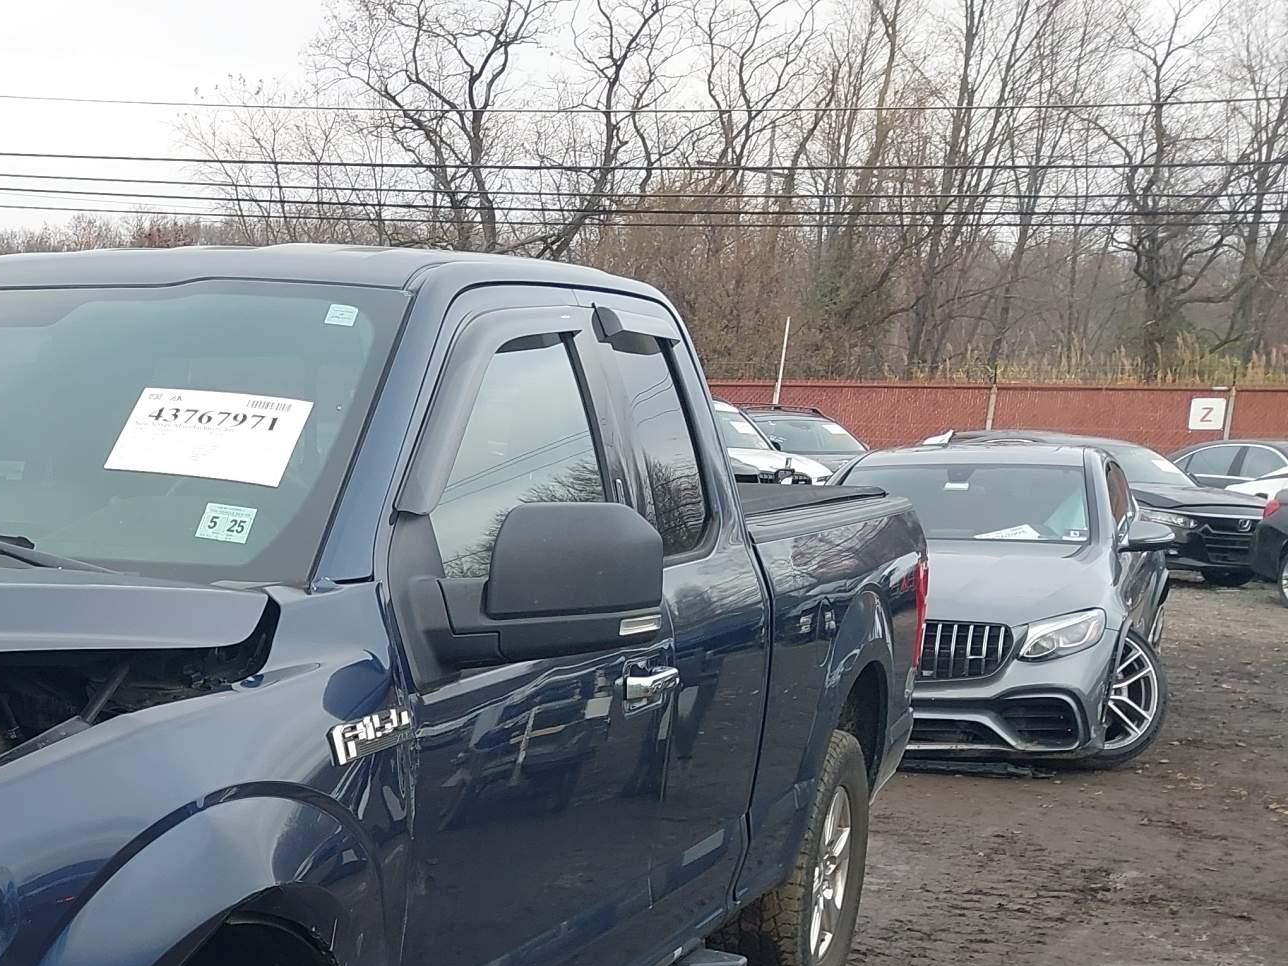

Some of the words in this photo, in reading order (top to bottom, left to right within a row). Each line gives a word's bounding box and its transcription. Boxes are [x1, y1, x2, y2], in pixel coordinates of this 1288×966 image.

[147, 407, 279, 431] 43767971
[1199, 407, 1214, 422] Z
[208, 516, 219, 529] 5
[226, 519, 247, 534] 25
